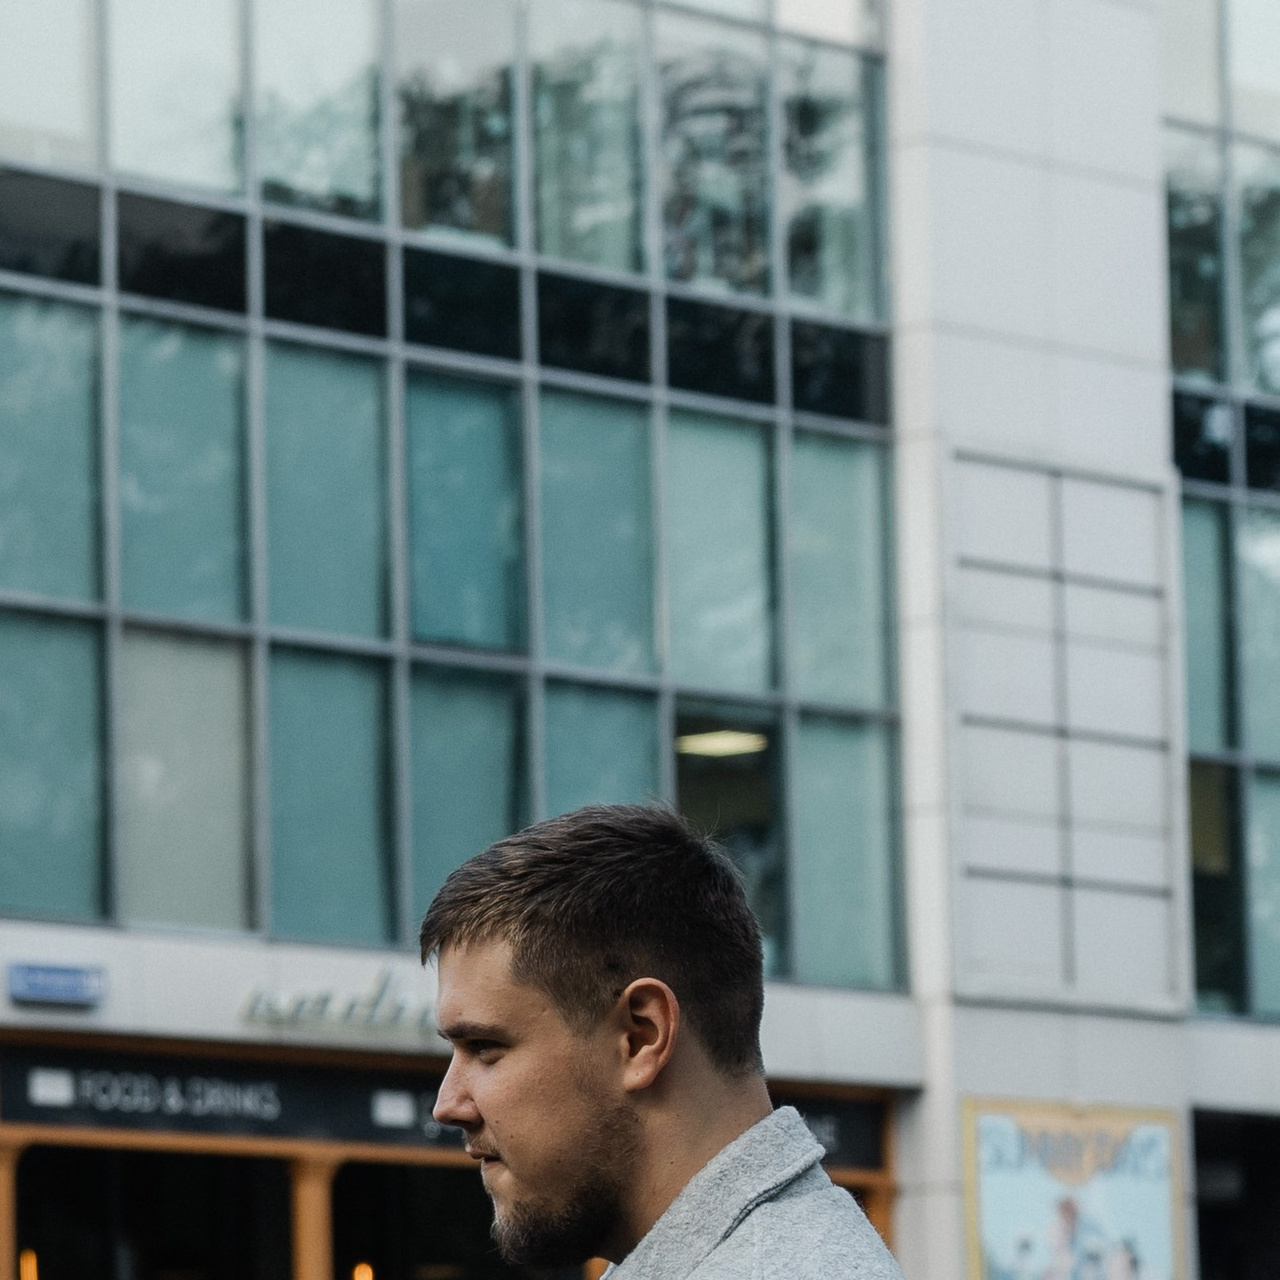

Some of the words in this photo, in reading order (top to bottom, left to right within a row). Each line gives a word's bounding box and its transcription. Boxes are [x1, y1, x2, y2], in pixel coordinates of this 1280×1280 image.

[78, 1069, 161, 1114] FOOD
[162, 1074, 183, 1116] &
[186, 1075, 282, 1121] DRINKS
